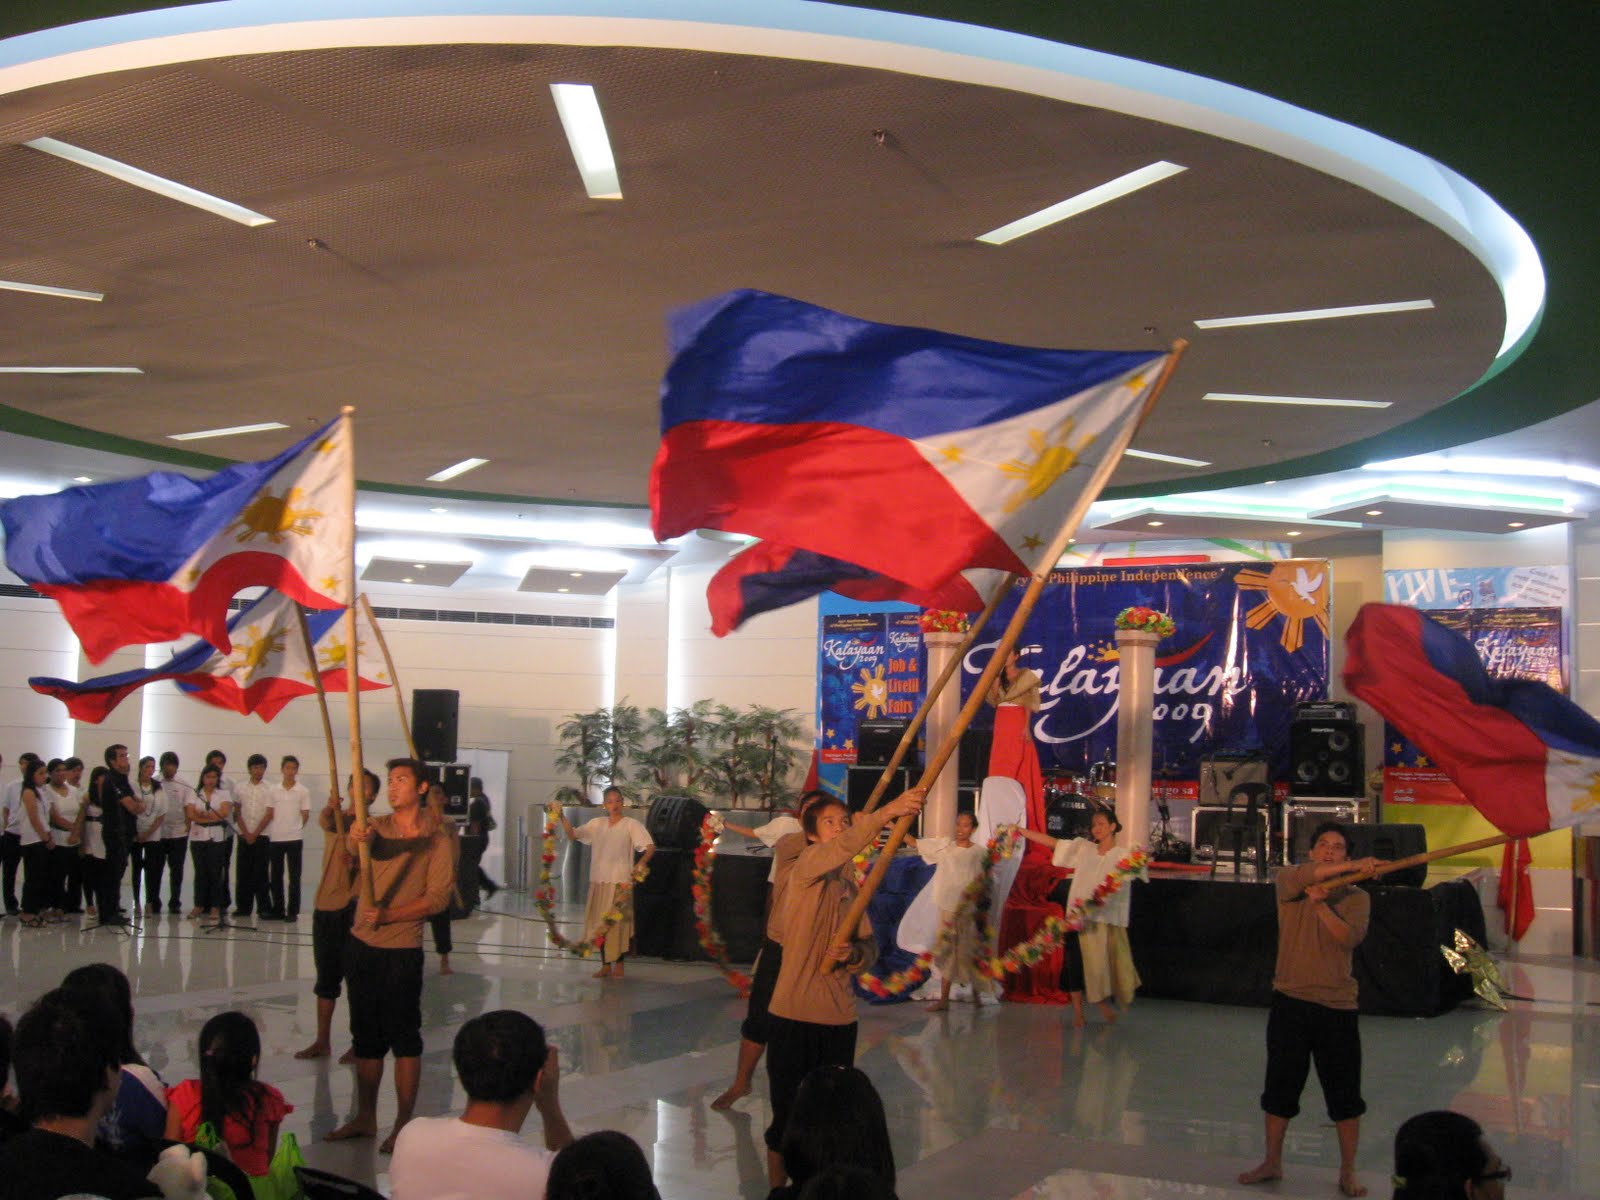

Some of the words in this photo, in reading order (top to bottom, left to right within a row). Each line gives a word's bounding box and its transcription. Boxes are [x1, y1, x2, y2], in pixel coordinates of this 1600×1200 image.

[1050, 571, 1116, 584] Philippine
[1121, 568, 1218, 584] Independence
[823, 639, 885, 670] Kalayaan
[858, 655, 878, 668] 2009
[888, 657, 906, 675] Job
[908, 656, 918, 673] &
[887, 699, 914, 714] Fairs
[1152, 702, 1214, 744] 009
